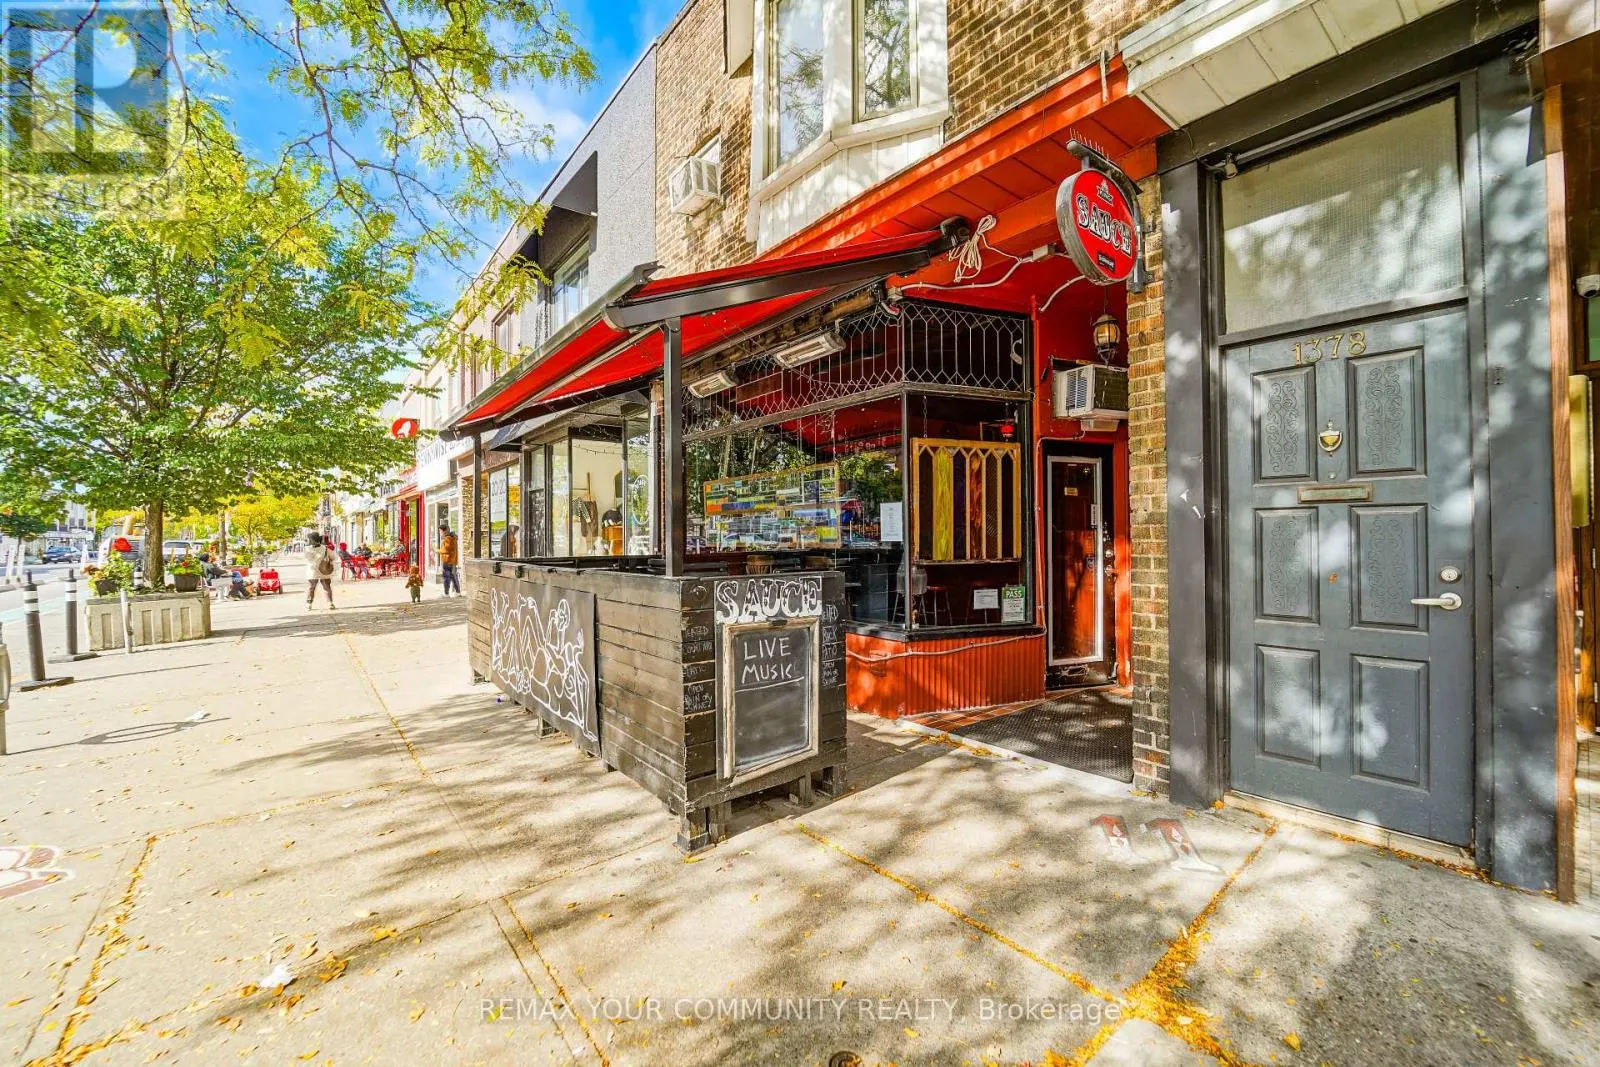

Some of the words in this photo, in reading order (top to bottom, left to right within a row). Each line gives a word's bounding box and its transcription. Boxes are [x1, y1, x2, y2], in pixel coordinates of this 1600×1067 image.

[1076, 193, 1132, 257] SAUCE
[1290, 330, 1366, 367] 1378
[716, 576, 822, 624] SAUCE
[744, 637, 791, 660] LIVE
[741, 663, 795, 684] MUSIC
